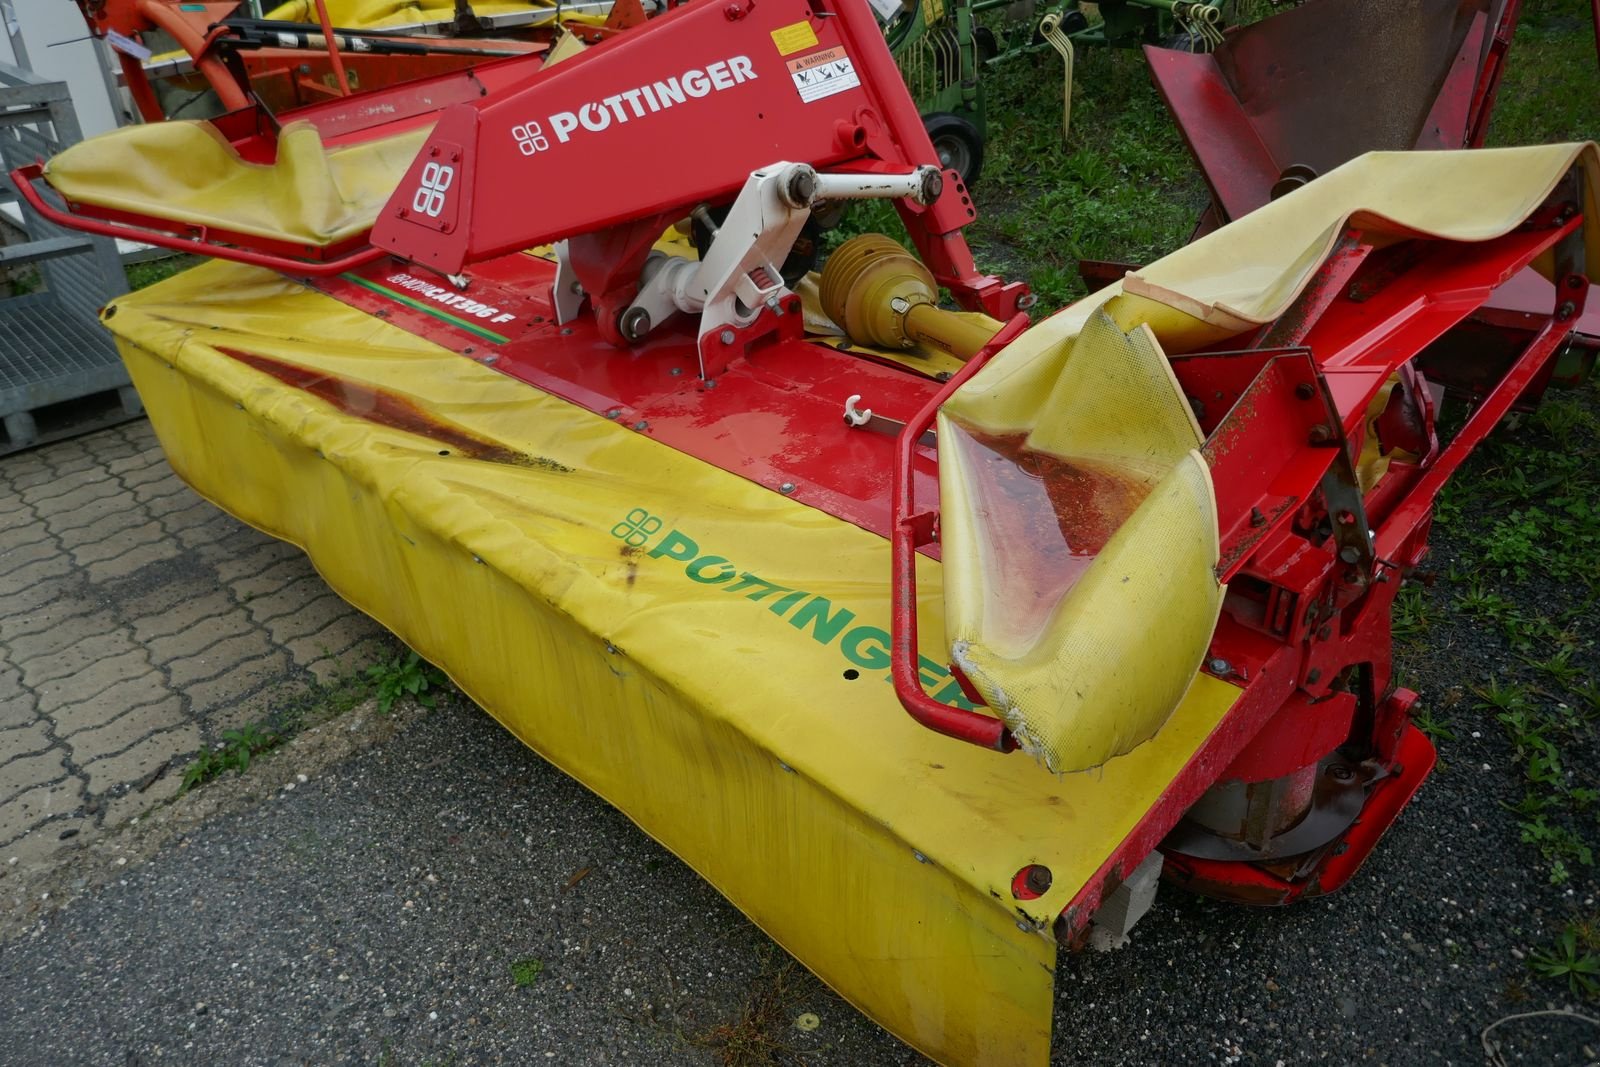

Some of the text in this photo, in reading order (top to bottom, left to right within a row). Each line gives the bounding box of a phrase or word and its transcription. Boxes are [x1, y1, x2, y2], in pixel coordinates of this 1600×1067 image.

[802, 50, 836, 66] WARNING
[547, 55, 758, 144] PÖTTINGER
[489, 313, 517, 323] F
